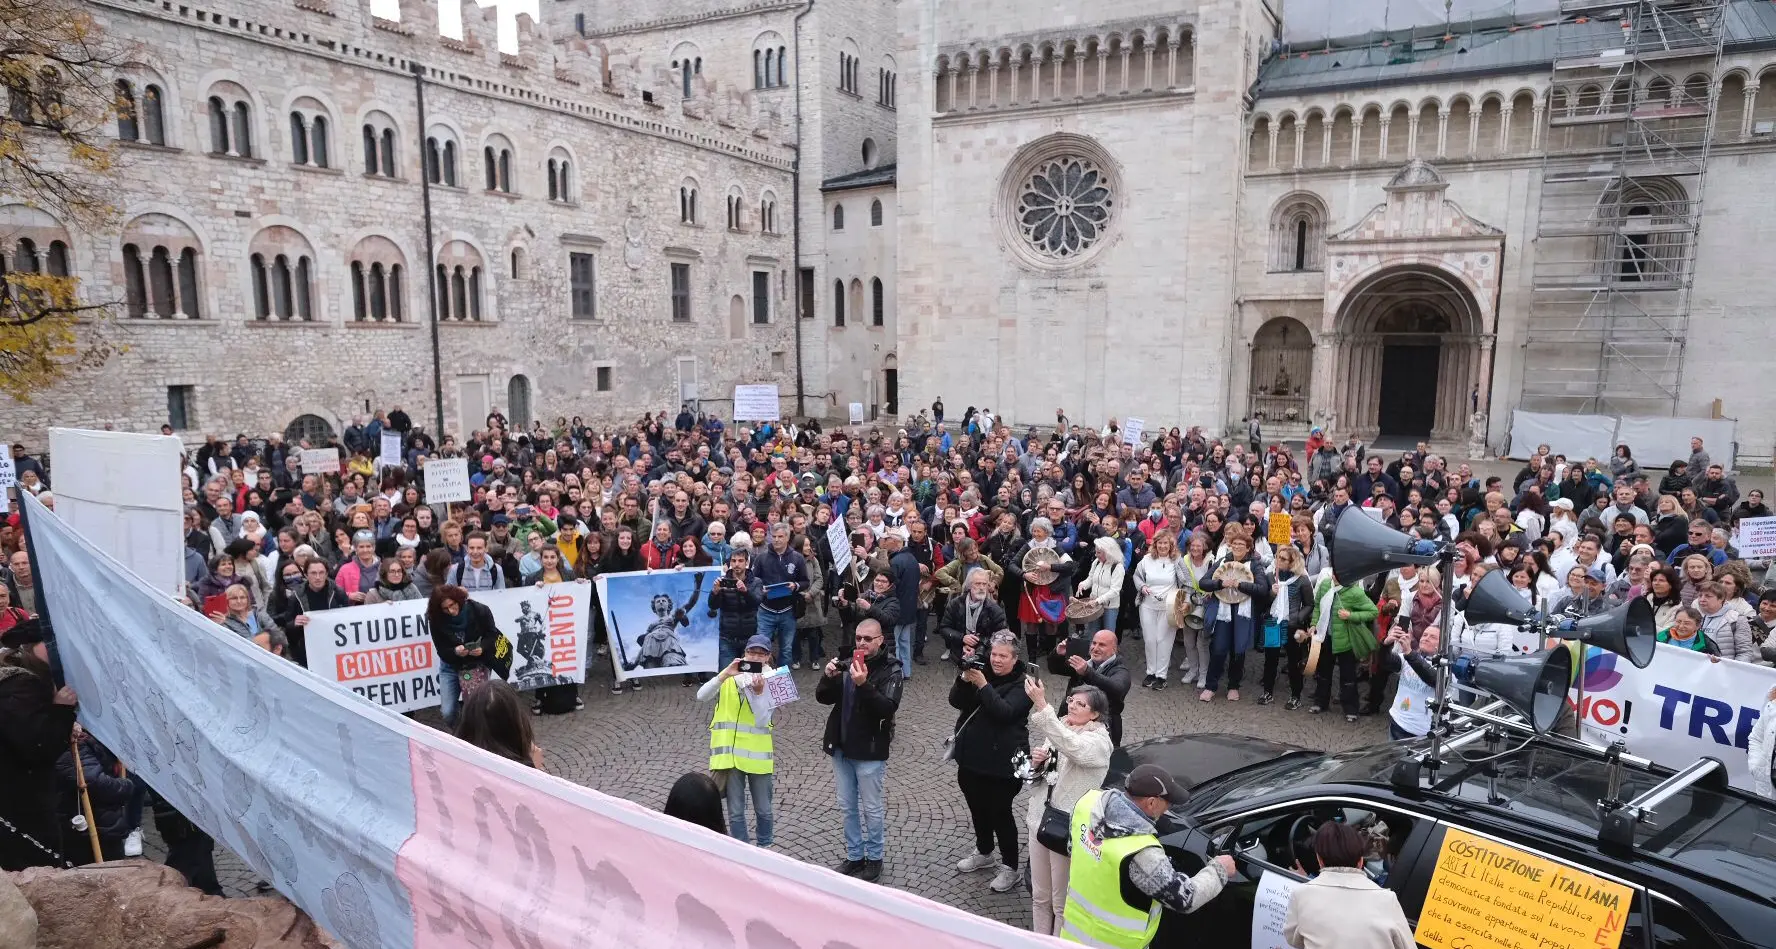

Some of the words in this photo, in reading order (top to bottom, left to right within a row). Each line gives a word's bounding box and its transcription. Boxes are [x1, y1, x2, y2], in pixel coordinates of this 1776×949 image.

[333, 614, 429, 647] STUDEN
[548, 594, 577, 678] TRENTO
[341, 644, 428, 679] CONTRO
[774, 676, 790, 702] NATI
[1449, 840, 1544, 882] COSTITUZIONE
[1550, 873, 1619, 911] ITALIANA
[1438, 874, 1491, 902] democratica
[1493, 896, 1527, 917] fondata
[1530, 913, 1544, 923] sul
[1481, 868, 1504, 888] Italia
[1518, 889, 1534, 900] una
[1538, 890, 1593, 922] Repubblica
[1423, 928, 1443, 944] della
[1427, 907, 1442, 920] che
[1443, 913, 1452, 924] la
[1455, 920, 1493, 941] esercita
[1494, 936, 1512, 949] nelle
[1484, 914, 1528, 936] appartiene
[1530, 933, 1538, 941] al
